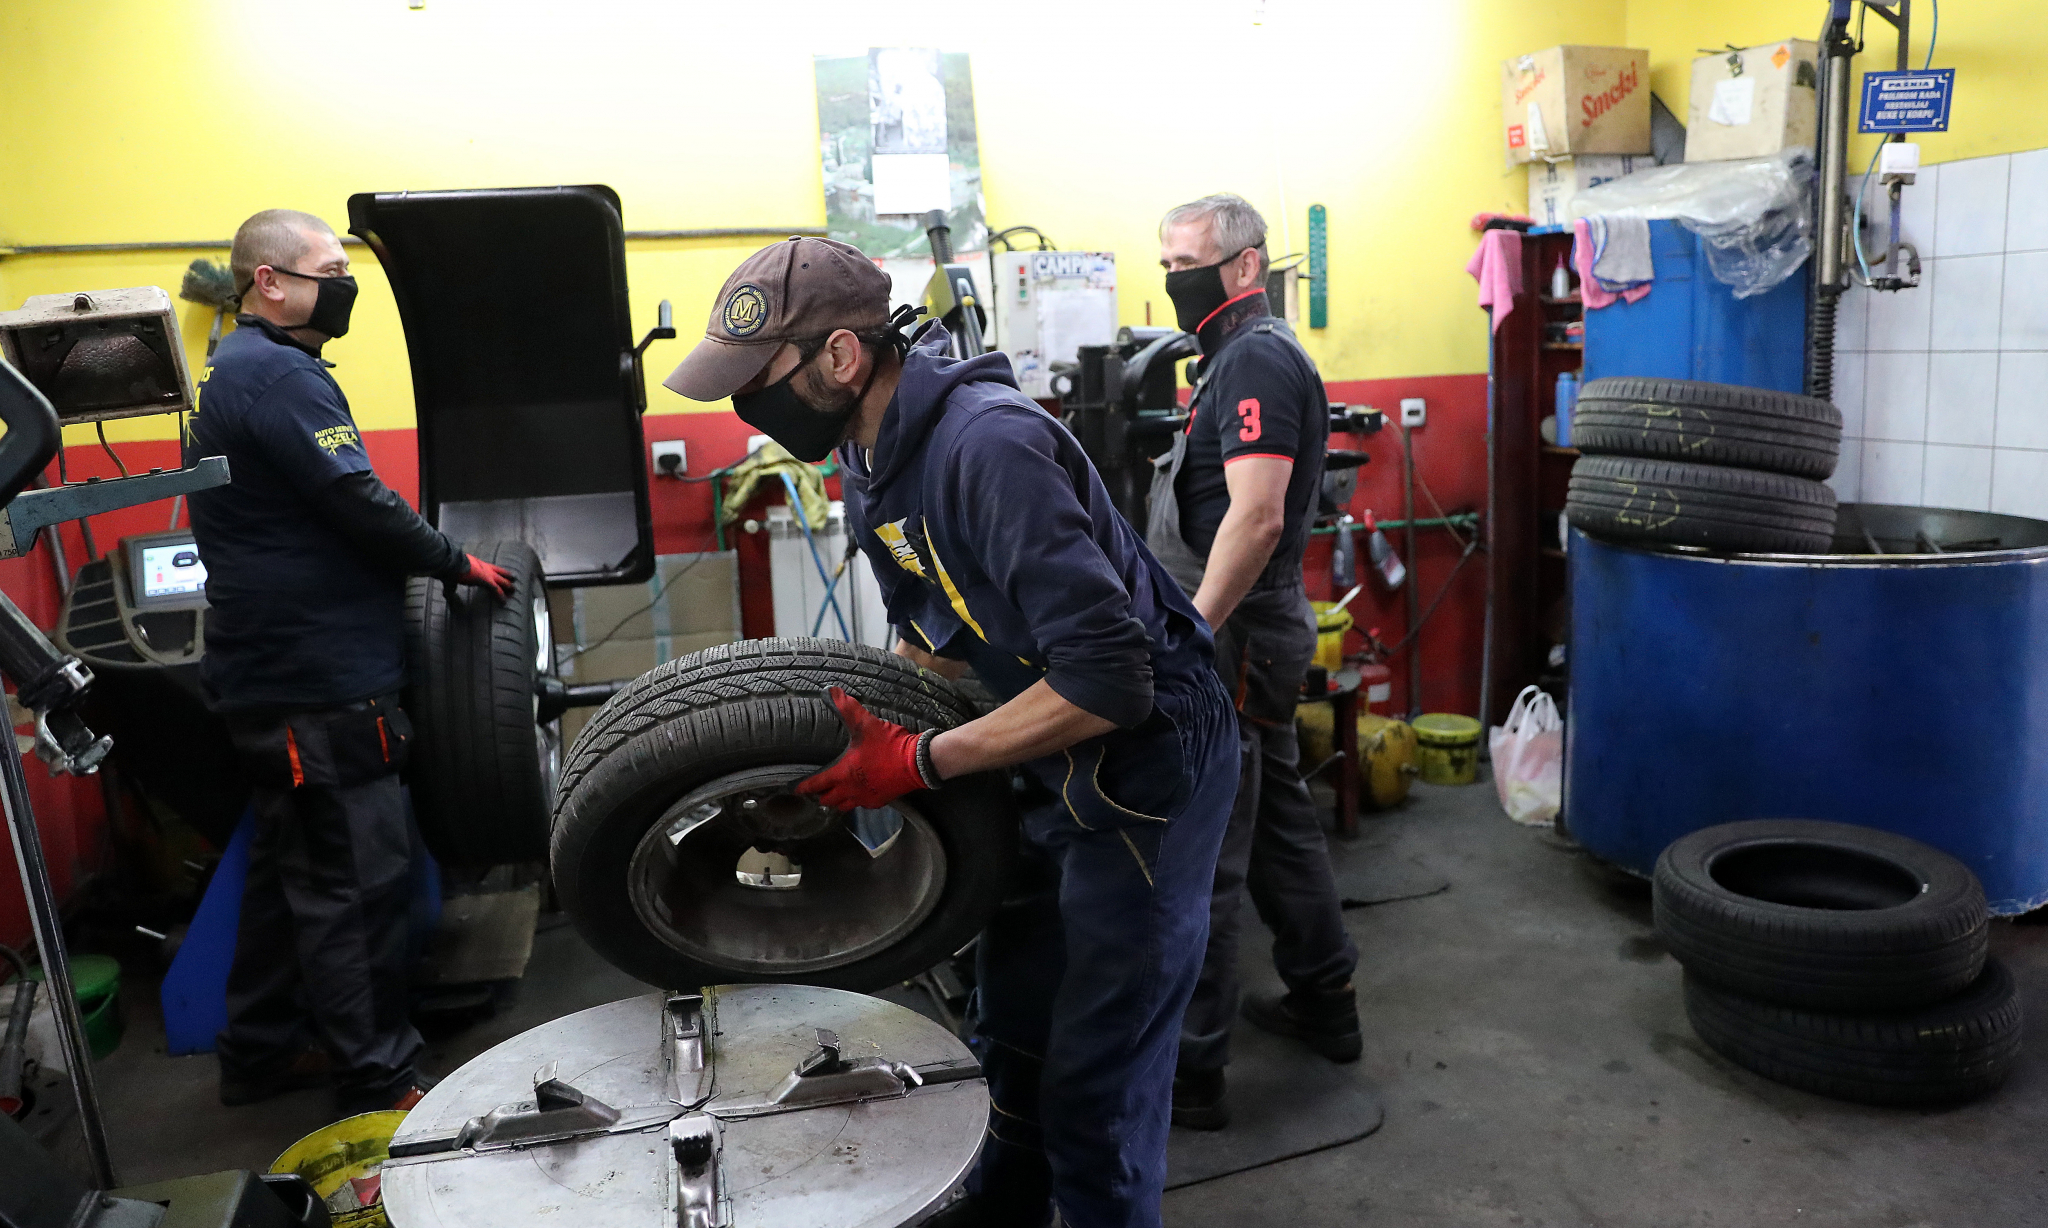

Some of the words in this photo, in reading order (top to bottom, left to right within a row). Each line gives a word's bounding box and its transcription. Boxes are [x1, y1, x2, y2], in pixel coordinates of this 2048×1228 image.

[1899, 110, 1906, 119] U
[731, 299, 757, 322] M
[1237, 398, 1262, 442] 3
[314, 427, 335, 439] AUTO
[318, 432, 358, 447] GAZELA
